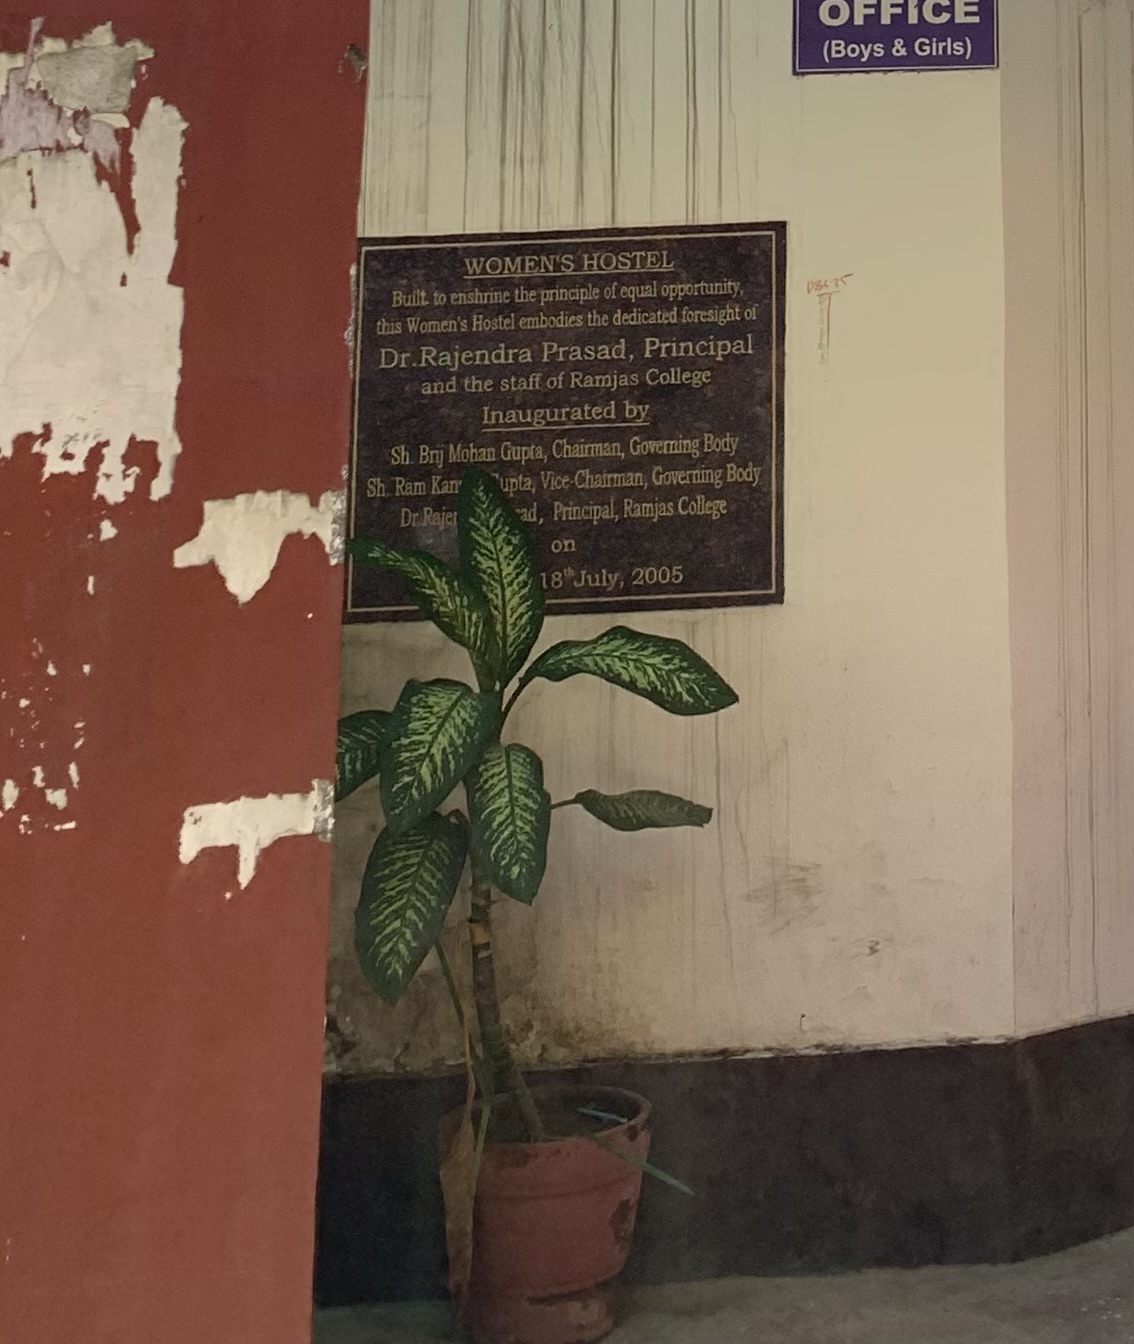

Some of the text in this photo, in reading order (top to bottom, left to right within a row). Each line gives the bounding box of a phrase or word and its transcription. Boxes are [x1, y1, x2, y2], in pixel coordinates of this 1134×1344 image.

[823, 36, 972, 63] (Boys & Girls)
[464, 250, 675, 275] WOMEN'S HOSTEL
[433, 290, 447, 306] to
[451, 287, 511, 306] enshrine
[515, 286, 537, 303] the
[541, 282, 600, 306] principle
[604, 282, 618, 299] of
[620, 280, 657, 302] equal
[661, 278, 744, 301] opportunity,
[377, 303, 758, 336] this Women's Hostel embodies the dedicated foresight of
[541, 338, 635, 363] Prasad,
[643, 333, 755, 361] Principal
[421, 367, 711, 395] and the staff of Ramjas College
[482, 400, 650, 427] Inaugurated by
[419, 444, 444, 469] Brij
[449, 442, 496, 463] Mohan
[501, 441, 548, 465] Gupta,
[552, 438, 625, 461] Chairman,
[630, 435, 700, 459] Governing
[704, 432, 739, 456] Body
[395, 477, 427, 497] Ram
[491, 472, 536, 497] upta,
[541, 468, 648, 491] Vice-Chairman,
[652, 465, 723, 489] Governing
[726, 461, 762, 486] Body
[553, 496, 619, 525] Principal,
[623, 497, 674, 522] Ramjas
[678, 494, 727, 520] College
[551, 538, 576, 553] on
[573, 569, 624, 591] July,
[631, 565, 684, 586] 2005
